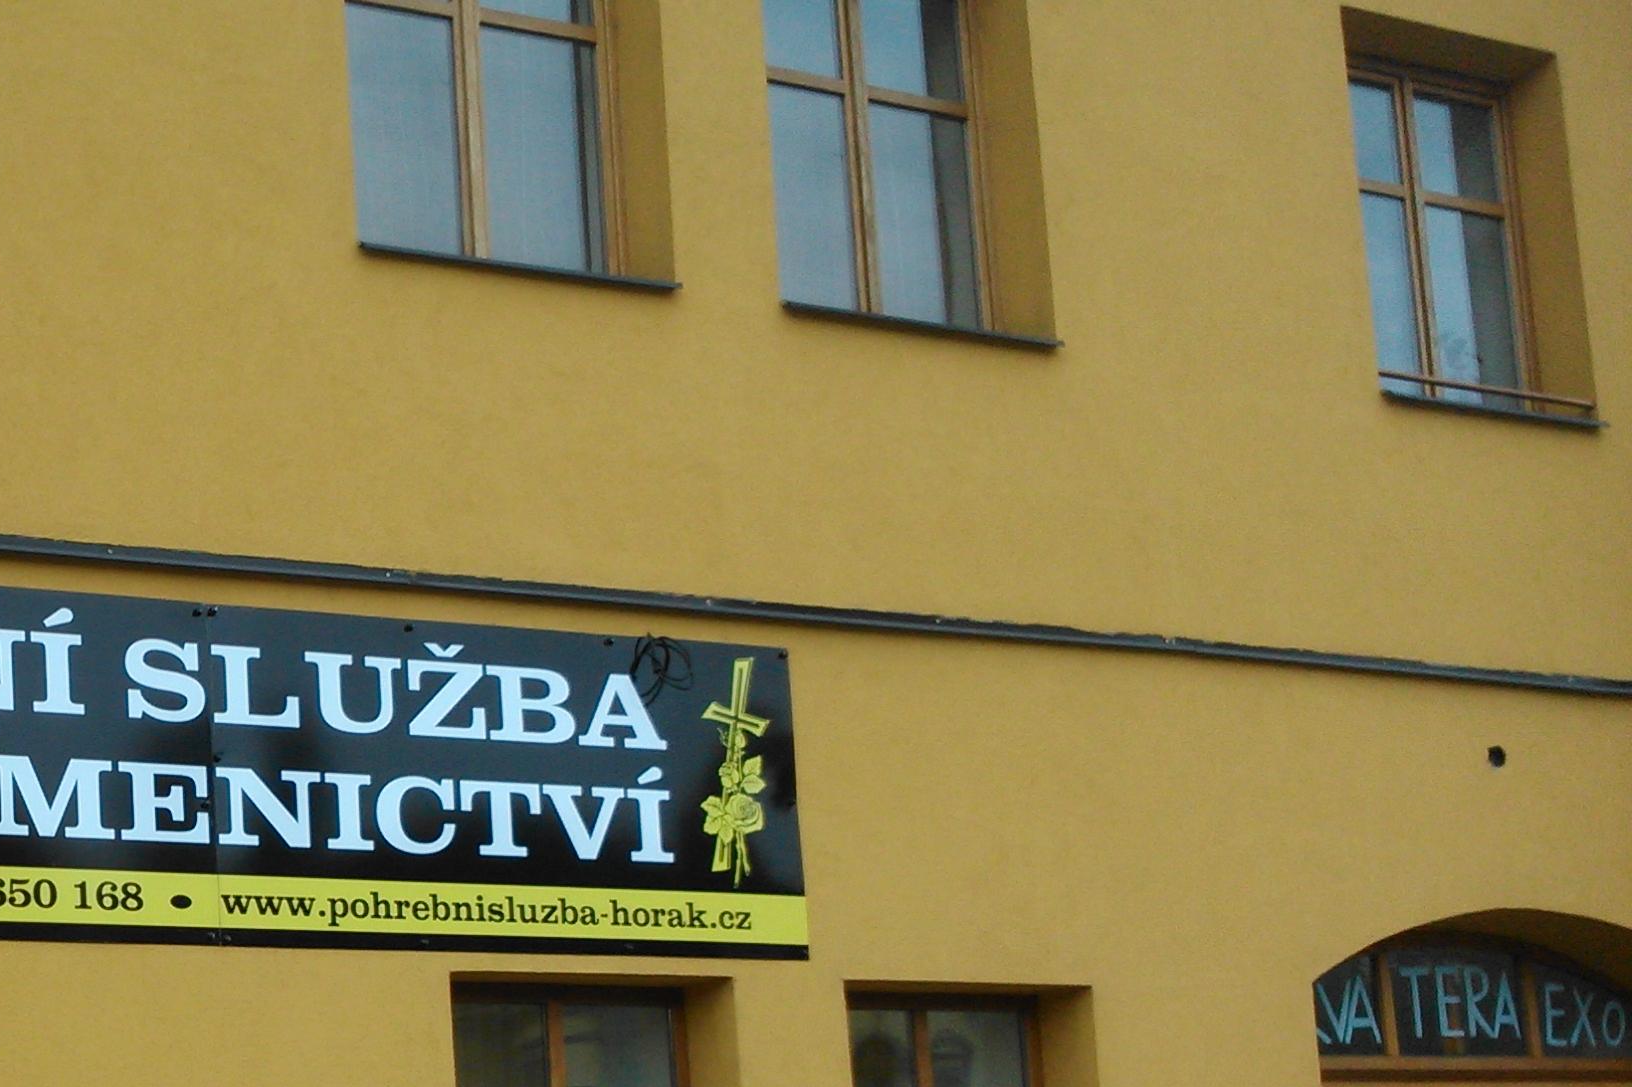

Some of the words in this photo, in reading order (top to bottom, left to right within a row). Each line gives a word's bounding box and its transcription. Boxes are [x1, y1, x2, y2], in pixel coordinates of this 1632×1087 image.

[124, 636, 669, 751] SLUŽBA
[74, 880, 145, 912] 168
[220, 892, 752, 931] www.pohrebnisluzba-horak.cz
[1316, 974, 1382, 1045] VA
[1398, 965, 1521, 1041] TERA
